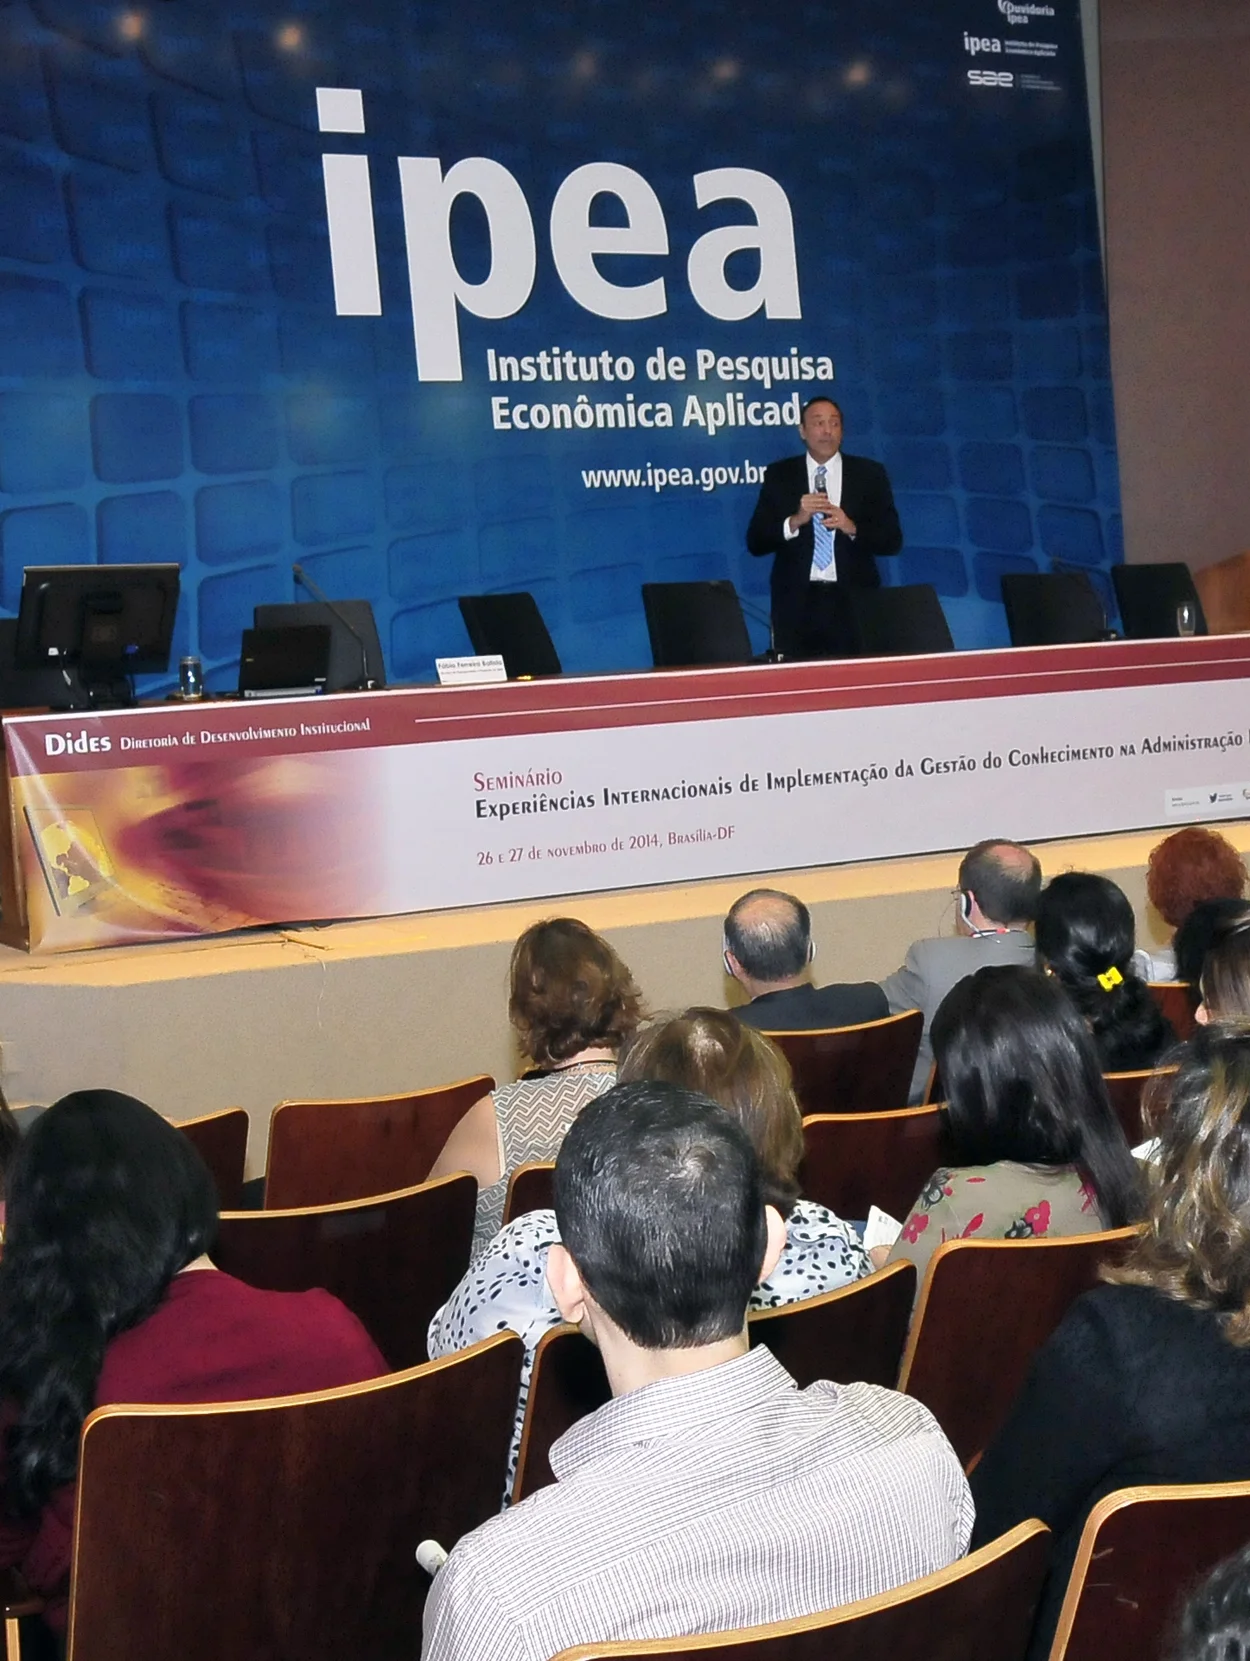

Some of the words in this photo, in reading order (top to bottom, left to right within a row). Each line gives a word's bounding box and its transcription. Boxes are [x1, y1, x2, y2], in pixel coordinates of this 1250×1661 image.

[964, 31, 1002, 56] ipea
[316, 87, 803, 383] ipea
[486, 346, 635, 382] Instituto
[646, 347, 686, 382] de
[696, 346, 835, 389] Pesquisa
[491, 394, 673, 430] Econômica
[682, 392, 801, 436] Aplicad
[581, 460, 768, 493] www.ipea.gov.br
[982, 751, 1002, 770] do
[476, 851, 494, 866] 26
[508, 847, 524, 863] 27
[629, 832, 664, 850] 2014,
